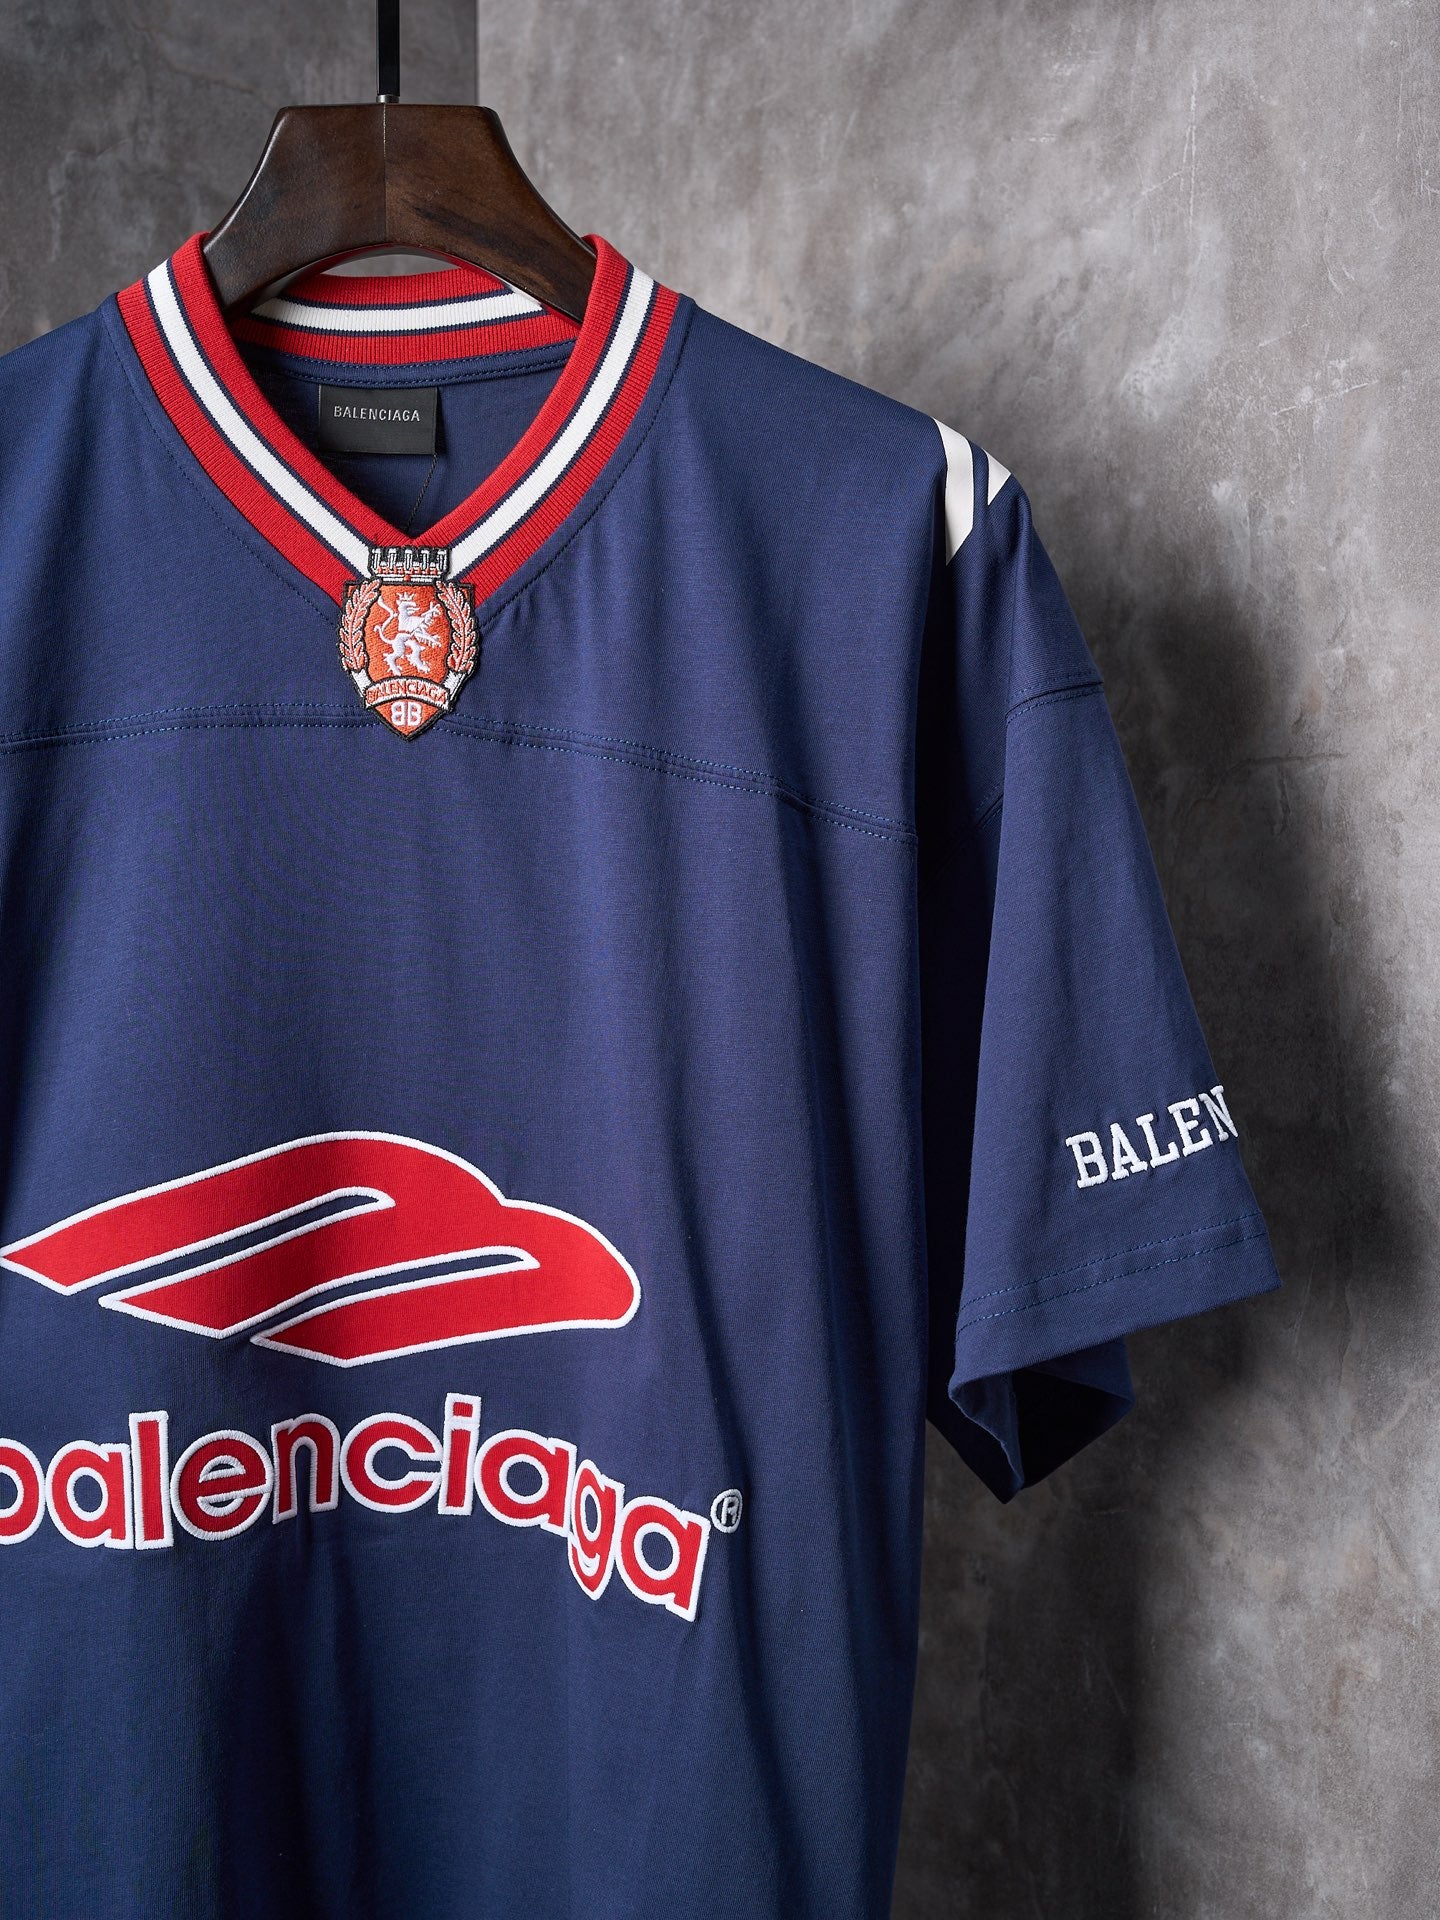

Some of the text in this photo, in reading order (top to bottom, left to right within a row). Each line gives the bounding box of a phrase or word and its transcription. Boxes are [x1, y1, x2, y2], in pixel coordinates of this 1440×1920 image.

[333, 405, 421, 422] BALENCIAGA
[365, 681, 450, 704] BALENCIAGA
[1065, 1085, 1239, 1189] BALEN
